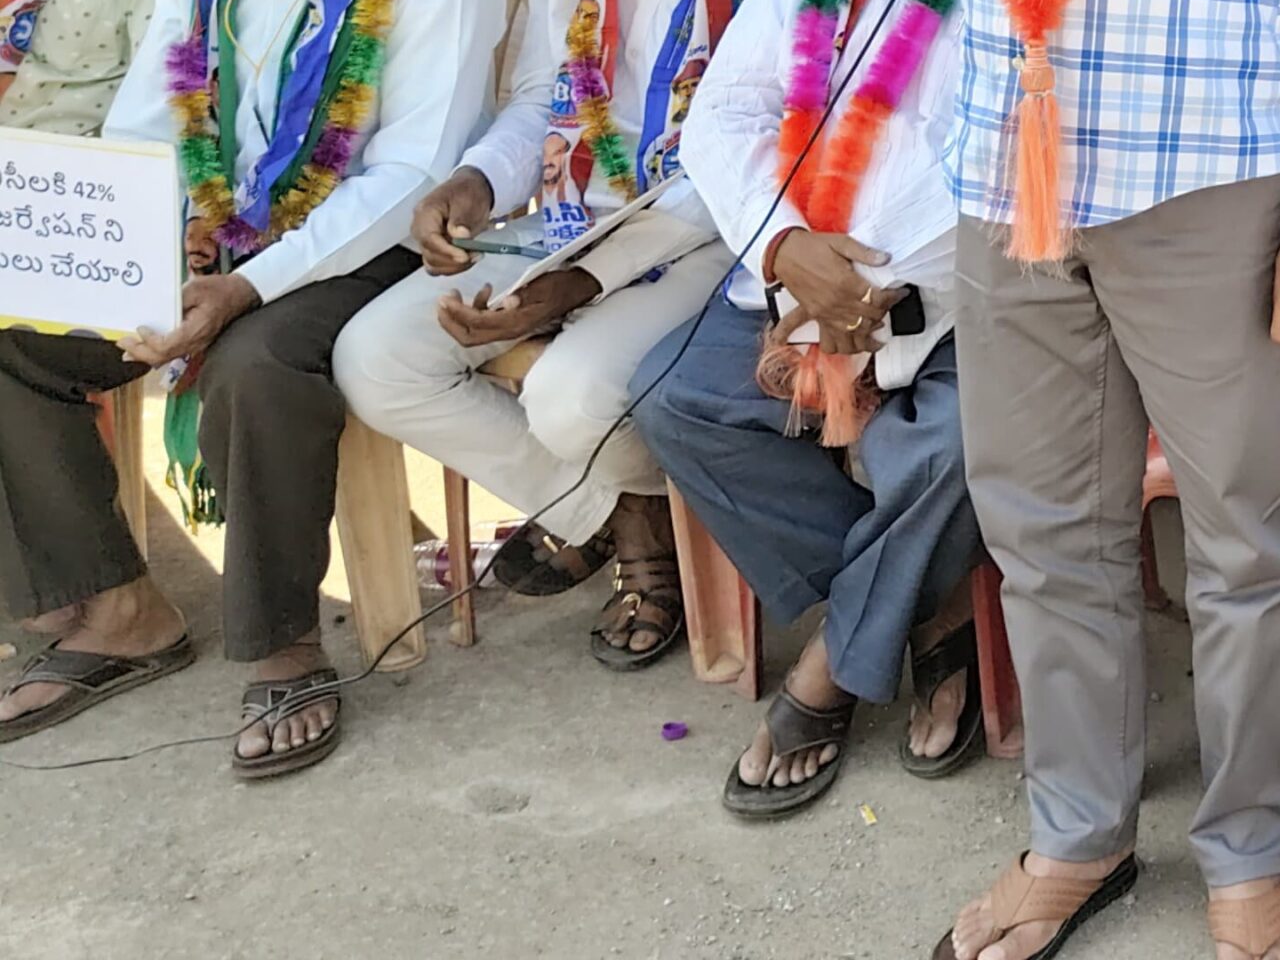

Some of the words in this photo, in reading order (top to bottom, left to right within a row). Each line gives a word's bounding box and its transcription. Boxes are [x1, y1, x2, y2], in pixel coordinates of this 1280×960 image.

[0, 161, 67, 196] సీలకి
[73, 181, 115, 203] 42%
[0, 204, 97, 239] జర్వేషన్
[104, 218, 124, 243] ని
[0, 251, 43, 274] లు
[51, 252, 144, 287] చేయాలి
